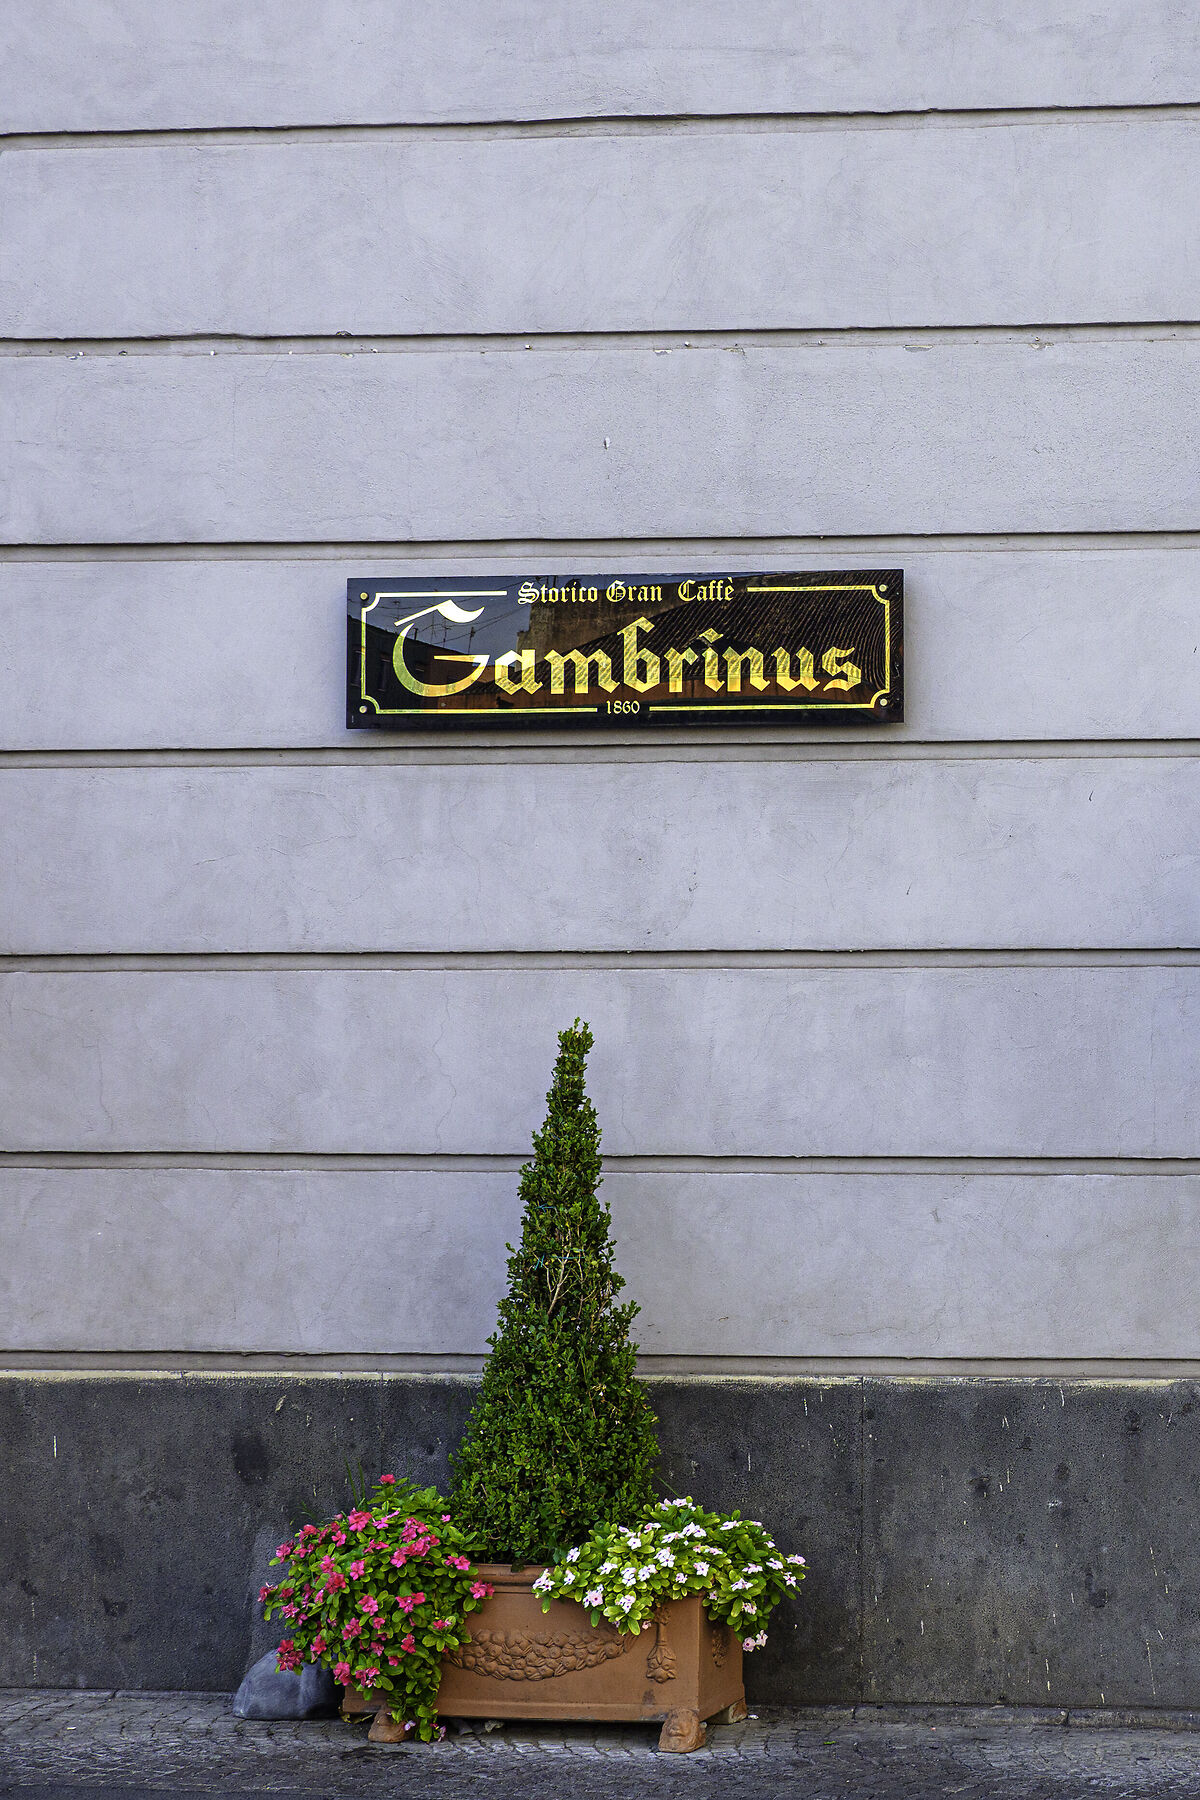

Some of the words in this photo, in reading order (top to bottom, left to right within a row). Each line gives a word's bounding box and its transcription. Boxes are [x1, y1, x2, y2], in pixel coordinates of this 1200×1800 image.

[518, 582, 598, 605] Storico
[605, 580, 663, 603] Gran
[677, 576, 735, 602] Caffè
[391, 598, 862, 697] Gambrinus
[606, 699, 640, 715] 1860
